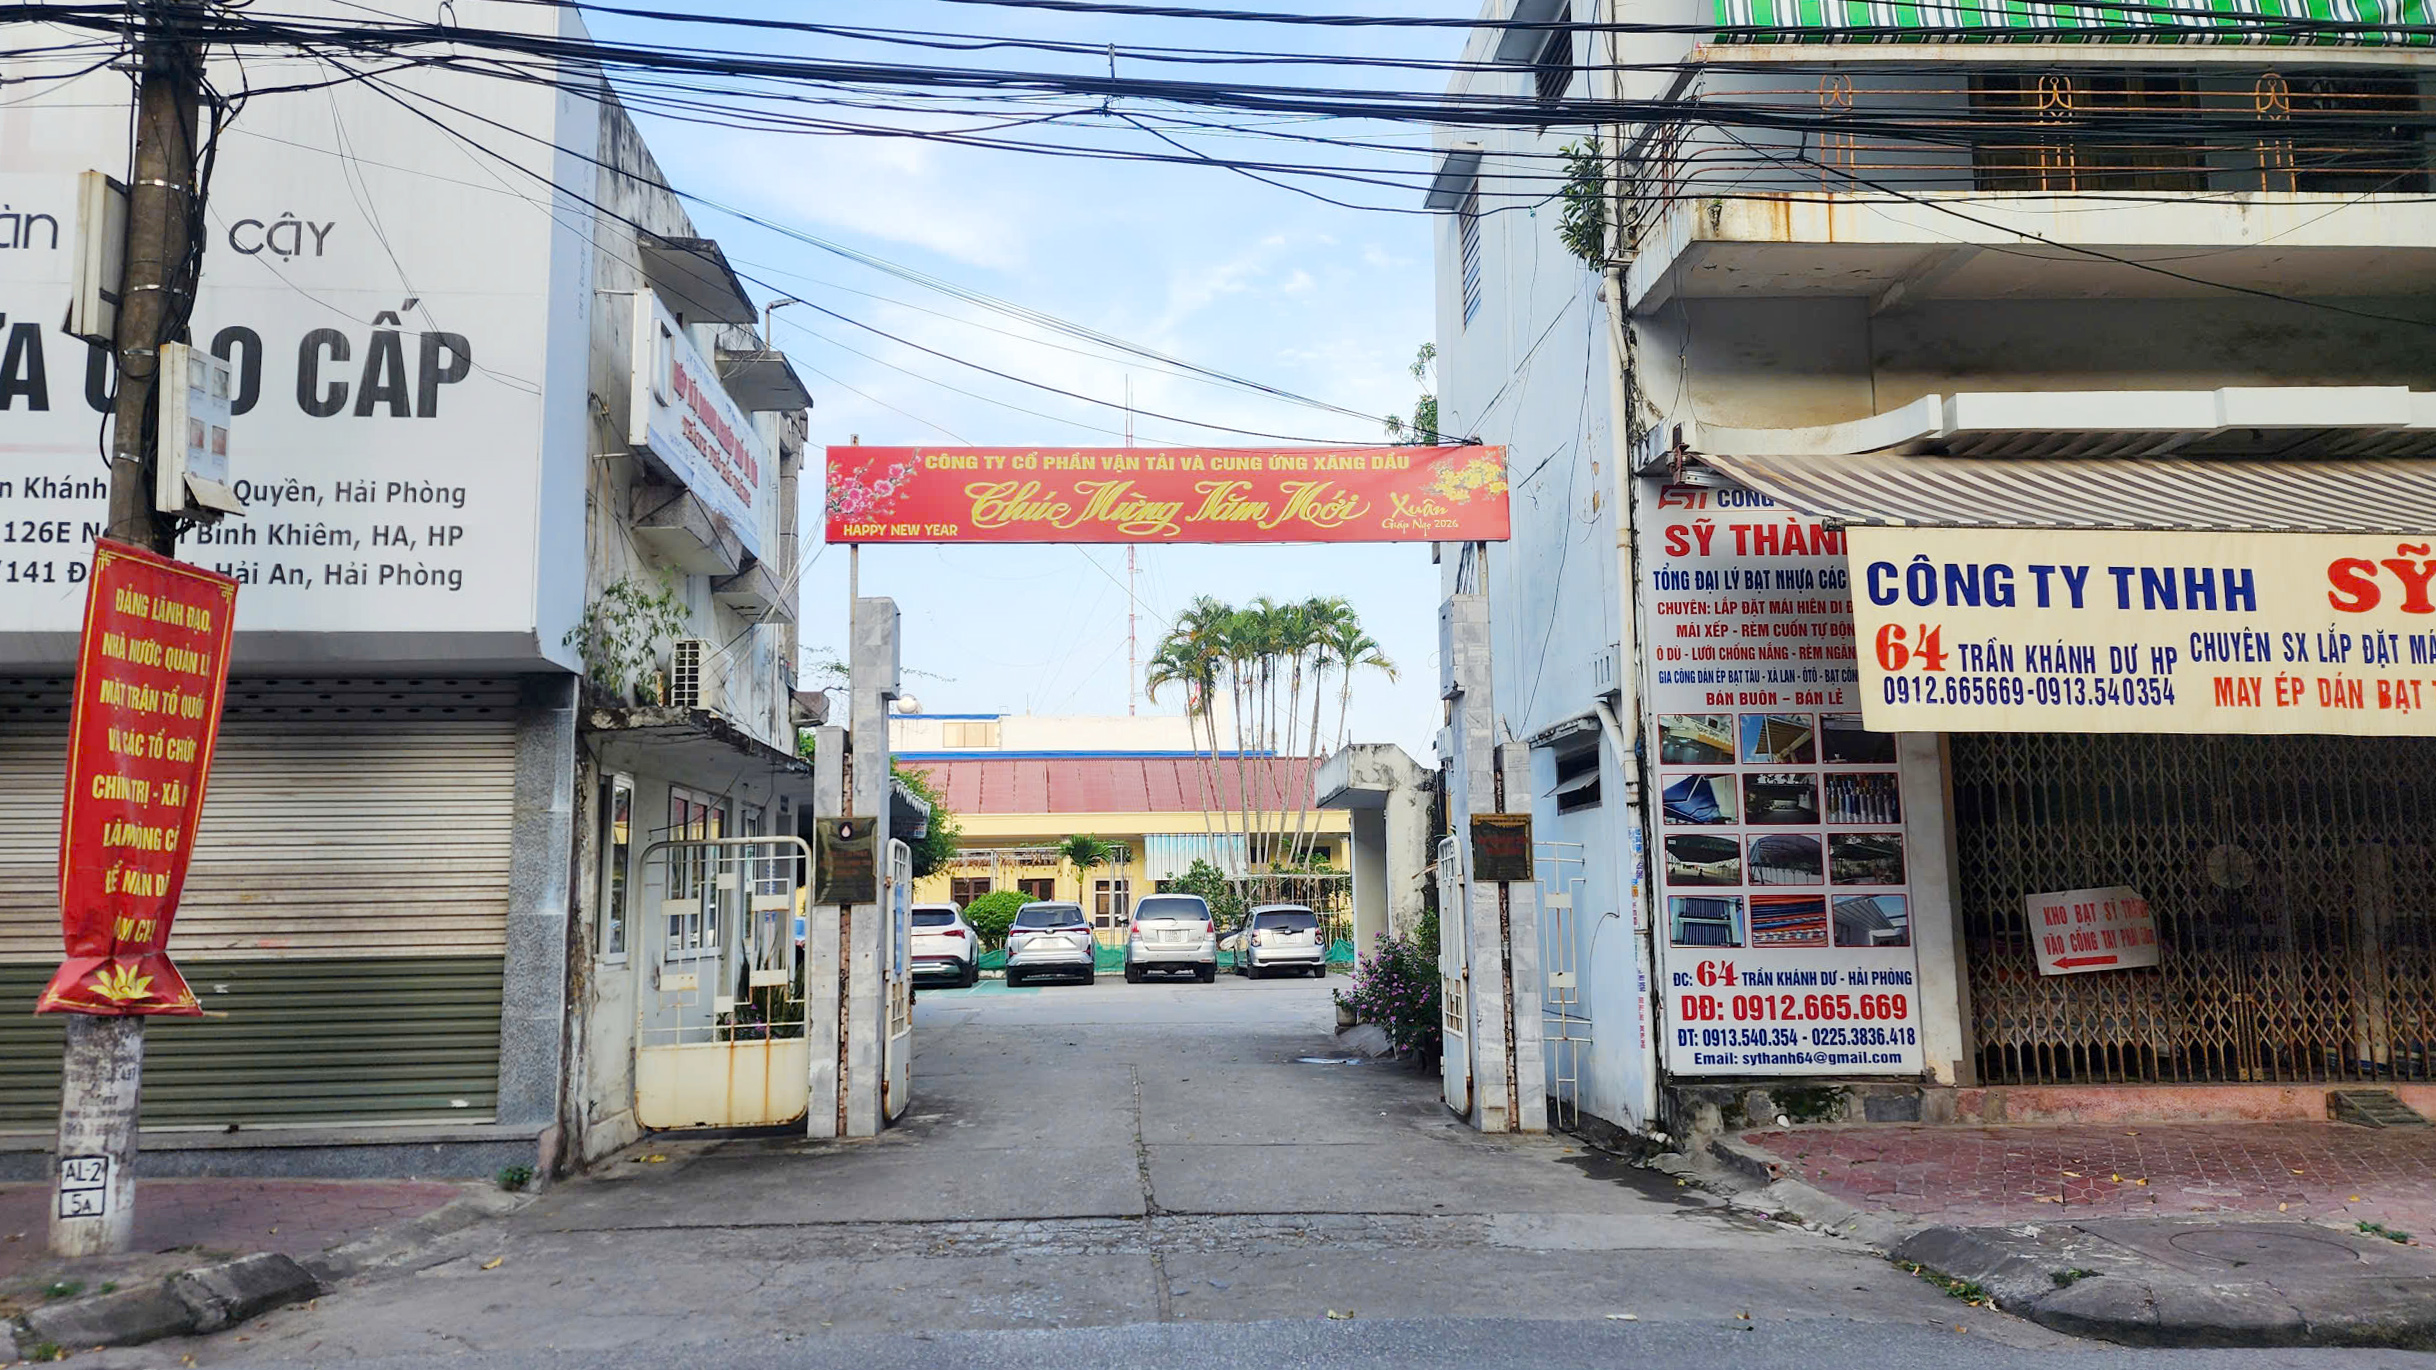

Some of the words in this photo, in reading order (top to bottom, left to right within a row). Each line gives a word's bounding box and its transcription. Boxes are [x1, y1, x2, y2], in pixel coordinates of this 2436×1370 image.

[229, 212, 336, 262] cậy
[85, 326, 262, 416] CO
[296, 298, 471, 419] CẤP
[925, 452, 978, 469] CÔNG
[983, 455, 1005, 469] TY
[1012, 451, 1037, 469] CỔ
[1044, 451, 1095, 470] PHẦN
[1101, 452, 1139, 473] VẬN
[1146, 452, 1174, 470] TẢI
[1180, 454, 1204, 470] VÀ
[1211, 456, 1262, 471] CUNG
[1268, 453, 1308, 470] ỨNG
[1314, 454, 1365, 470] XĂNG
[1371, 452, 1410, 470] DẦU
[24, 475, 107, 499] Khánh
[233, 478, 323, 507] Quyền,
[335, 479, 376, 503] Hải
[386, 480, 466, 508] Phòng
[964, 480, 1071, 529] Chúc
[1055, 480, 1183, 536] Mừng
[1185, 481, 1270, 522] Năm
[1257, 481, 1371, 529] Mới
[1390, 491, 1448, 518] Xuân
[4, 521, 71, 543] 126E
[268, 523, 360, 551] Khiêm,
[372, 525, 416, 551] HA,
[428, 525, 463, 546] HP
[843, 524, 887, 536] HAPPY
[890, 524, 920, 536] NEW
[925, 524, 958, 536] YEAR
[1434, 519, 1458, 528] 2026
[1664, 518, 1716, 557] SỸ
[0, 561, 55, 583] 141
[268, 563, 313, 590] An,
[324, 561, 367, 585] Hải
[379, 562, 463, 591] Phòng
[1653, 562, 1690, 590] TỔNG
[1695, 570, 1719, 594] ĐẠI
[1725, 566, 1740, 590] LÝ
[1745, 570, 1770, 594] BẠT
[1776, 569, 1814, 593] NHỰA
[1819, 565, 1847, 590] CÁC
[1867, 553, 2015, 607] CÔNG
[2028, 565, 2089, 610] TY
[2108, 566, 2257, 612] TNHH
[2327, 542, 2436, 614] SỸ
[115, 583, 149, 618] ĐẢNG
[151, 596, 183, 626] LÃNH
[186, 606, 211, 635] ĐẠO,
[1657, 598, 1711, 615] CHUYÊN:
[1714, 596, 1737, 614] LẮP
[1741, 599, 1765, 617] ĐẶT
[1769, 598, 1793, 614] MÁI
[1797, 597, 1826, 614] HIÊN
[1830, 601, 1842, 614] DI
[1676, 622, 1700, 638] MÁI
[1704, 620, 1729, 638] XẾP
[1741, 621, 1769, 637] RÈM
[1773, 619, 1807, 637] CUỐN
[1811, 622, 1827, 639] TỰ
[101, 631, 126, 660] NHÀ
[128, 638, 162, 668] NƯỚC
[164, 643, 198, 675] QUẢN
[1656, 645, 1664, 661] Ô
[1667, 645, 1681, 660] DÙ
[1692, 644, 1716, 661] LƯỚI
[1718, 642, 1755, 660] CHỐNG
[1758, 642, 1789, 660] NẮNG
[1799, 645, 1823, 660] RÈM
[1875, 622, 1949, 672] 64
[1958, 636, 2015, 673] TRẦN
[2025, 639, 2096, 674] KHÁNH
[2110, 643, 2138, 674] DƯ
[2151, 646, 2178, 675] HP
[2190, 626, 2271, 664] CHUYÊN
[2282, 632, 2309, 663] SX
[2317, 622, 2352, 664] LẮP
[2362, 628, 2399, 669] ĐẶT
[1658, 670, 1672, 684] GIA
[1674, 667, 1696, 684] CÔNG
[1716, 668, 1726, 683] ÉP
[1728, 670, 1744, 686] BẠT
[1745, 668, 1760, 683] TÀU
[1780, 669, 1796, 683] LAN
[1802, 667, 1818, 683] ÔTÔ
[1825, 669, 1840, 686] BẠT
[1883, 675, 2175, 706] 0912.665669-0913.540354
[100, 676, 127, 711] MẶT
[127, 683, 159, 716] TRẬN
[162, 685, 181, 715] TỔ
[181, 691, 205, 719] QUỐ
[1706, 689, 1734, 706] BÁN
[1739, 689, 1778, 706] BUÔN
[1795, 689, 1823, 705] BÁN
[1828, 688, 1844, 705] LẺ
[2213, 676, 2262, 708] MAY
[2274, 671, 2305, 708] ÉP
[2317, 672, 2364, 710] DÁN
[2377, 679, 2421, 715] BẠT
[148, 728, 166, 760] TỔ
[131, 779, 150, 809] TRỊ
[161, 780, 180, 807] XÃ
[2043, 905, 2068, 926] KHO
[2074, 902, 2097, 926] BẠT
[2043, 933, 2065, 955] VÀO
[2069, 926, 2099, 953] CỔNG
[1673, 972, 1693, 987] ĐC:
[1696, 960, 1738, 987] 64
[1742, 967, 1773, 986] TRẦN
[1777, 968, 1817, 986] KHÁNH
[1821, 969, 1838, 986] DƯ
[1848, 967, 1869, 986] HẢI
[1872, 967, 1912, 986] PHÒNG
[1681, 995, 1724, 1021] DĐ:
[1732, 993, 1907, 1021] 0912.665.669
[1678, 1028, 1698, 1047] ĐT:
[1702, 1027, 1798, 1047] 0913.540.354
[1811, 1027, 1916, 1046] 0225.3836.418
[1694, 1051, 1738, 1065] Email:
[1742, 1051, 1902, 1066] sythanh64@gmail.com
[66, 1161, 101, 1182] AL-2
[71, 1193, 92, 1215] 5A
